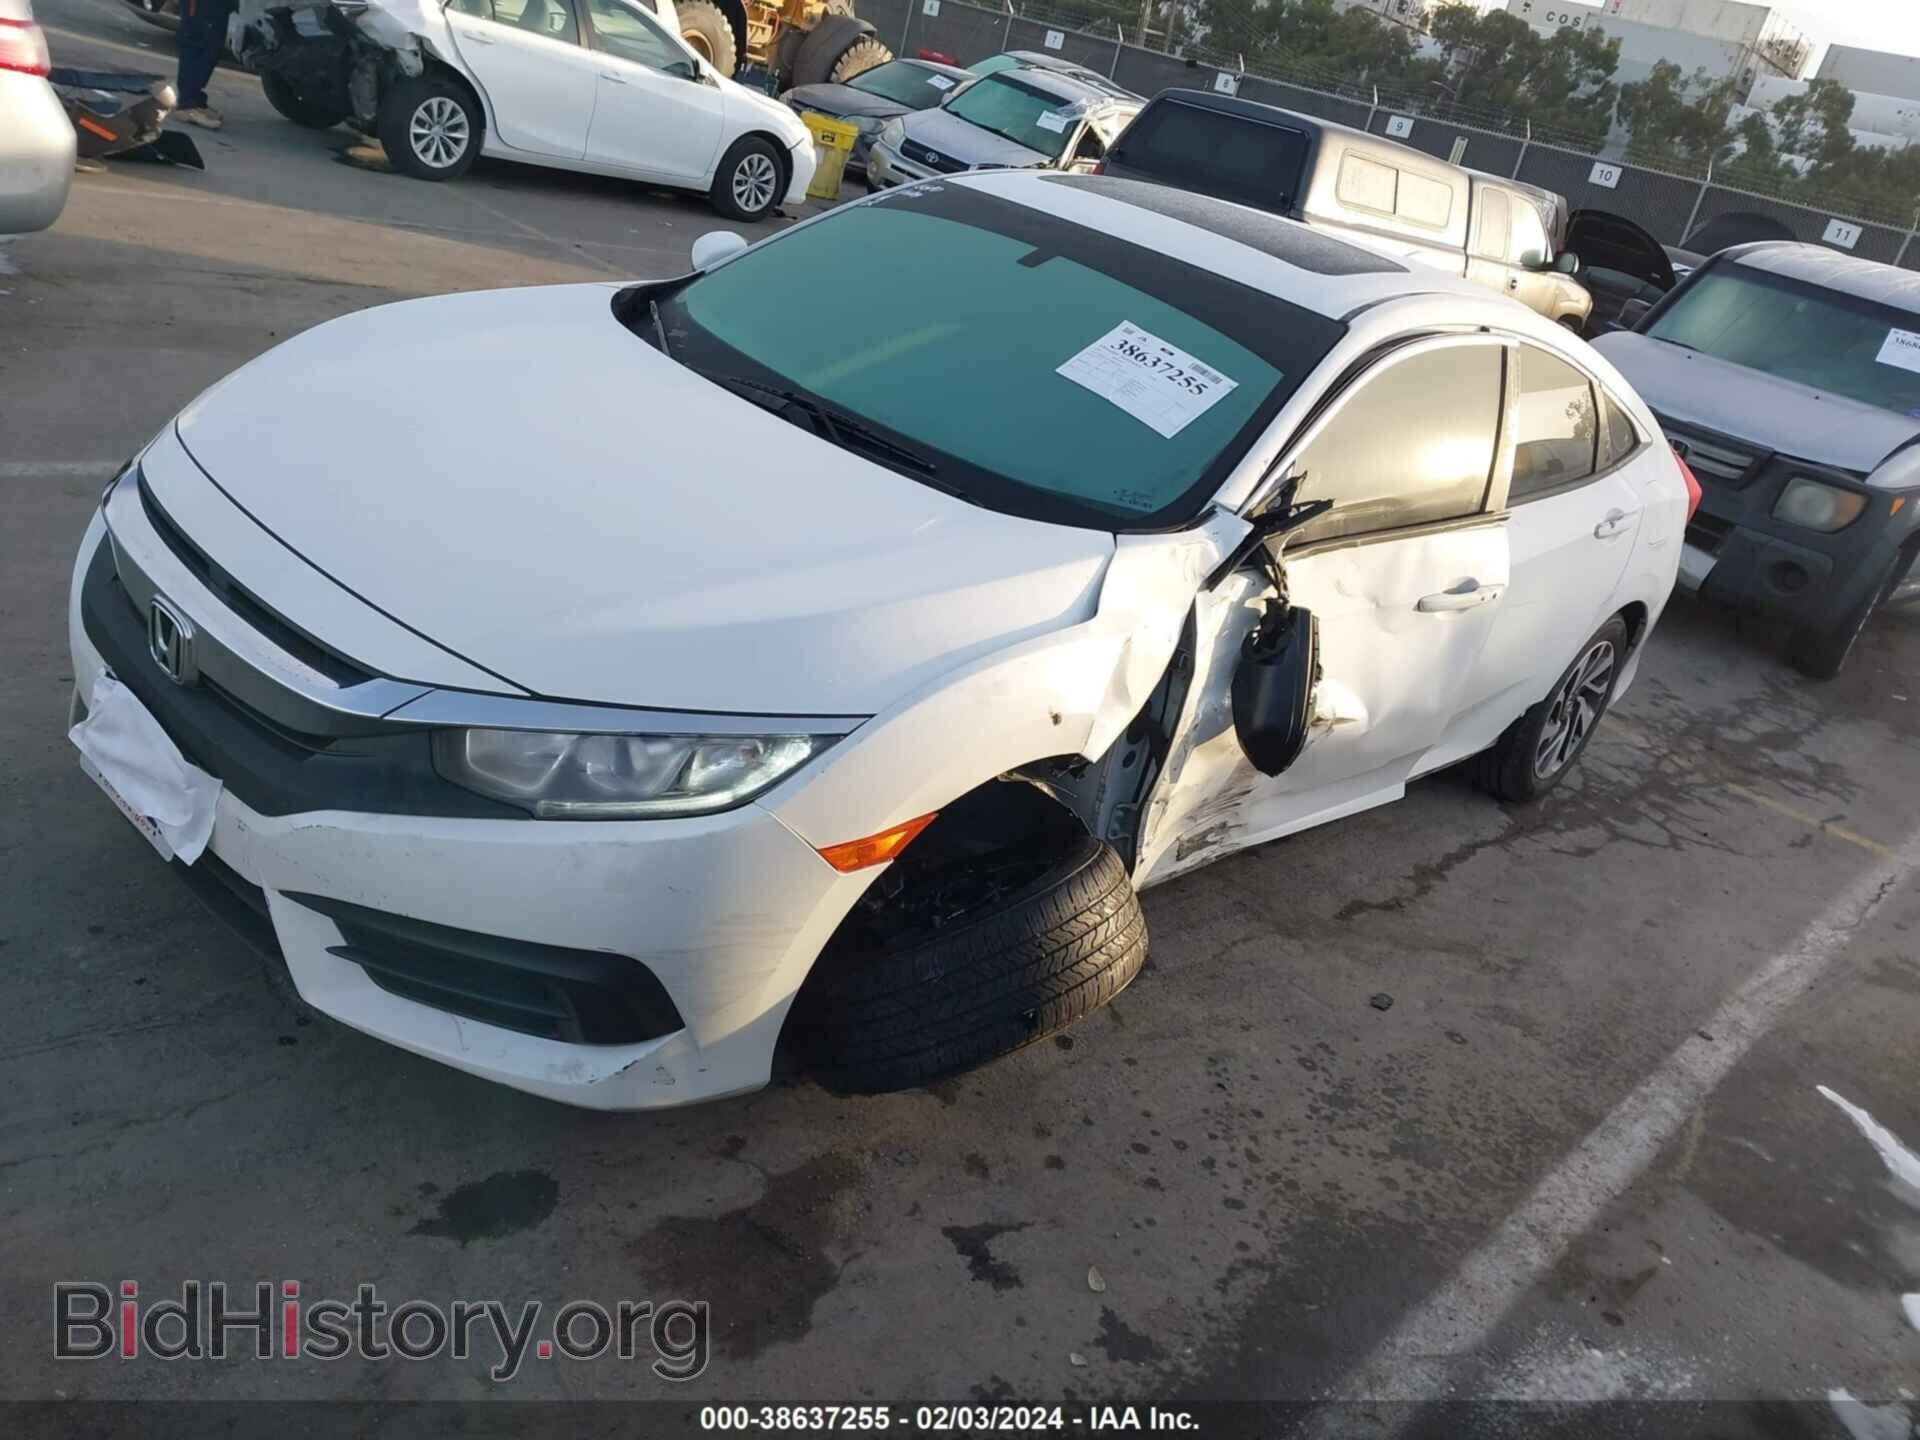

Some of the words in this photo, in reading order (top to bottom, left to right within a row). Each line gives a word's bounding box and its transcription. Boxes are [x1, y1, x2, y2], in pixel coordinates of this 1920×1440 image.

[1396, 121, 1404, 132] 9
[1598, 169, 1613, 182] 10
[1835, 227, 1851, 242] 11
[1110, 339, 1209, 396] 38637255
